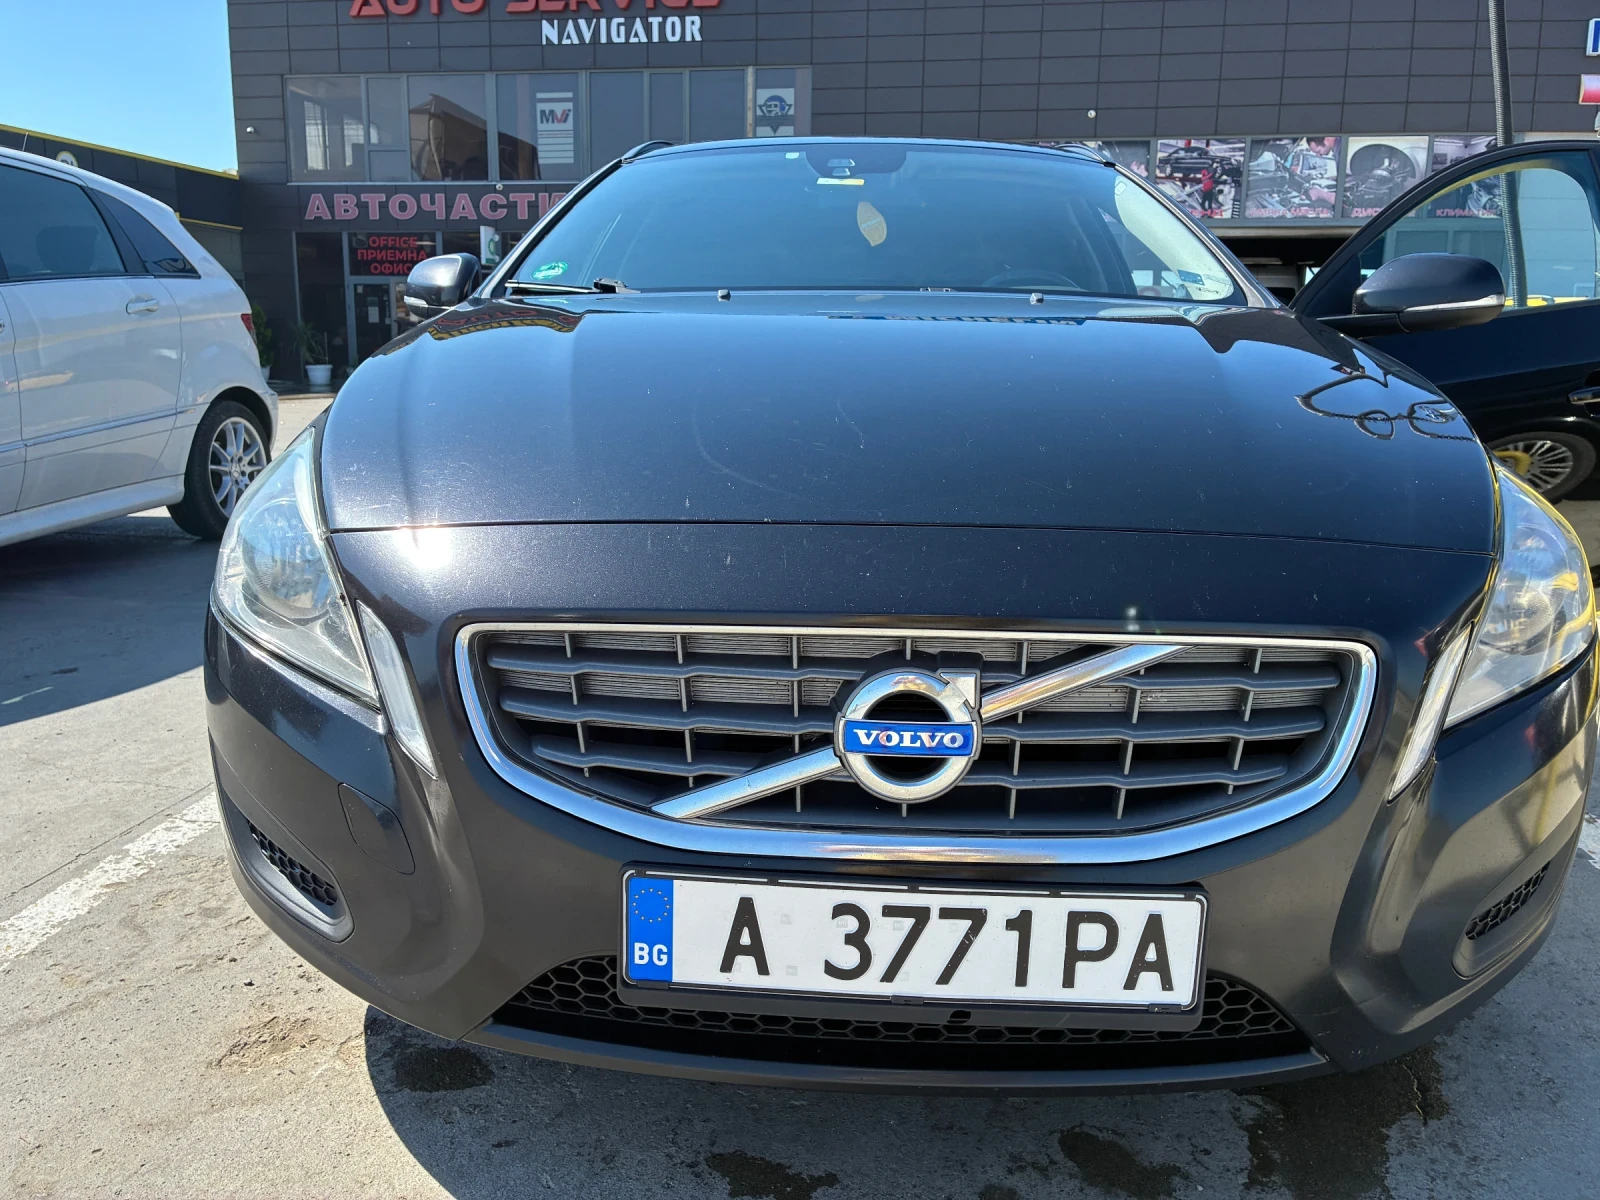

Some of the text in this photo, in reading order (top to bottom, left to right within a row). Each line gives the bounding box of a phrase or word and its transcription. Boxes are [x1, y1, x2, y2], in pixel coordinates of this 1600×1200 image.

[541, 15, 703, 45] NAVIGATOR
[368, 236, 418, 248] OFFICE
[357, 249, 427, 261] ПРИЕМНА
[370, 262, 412, 275] ОФИС
[853, 728, 965, 749] VOLVO
[633, 942, 668, 967] BG
[823, 902, 1033, 987] 3771
